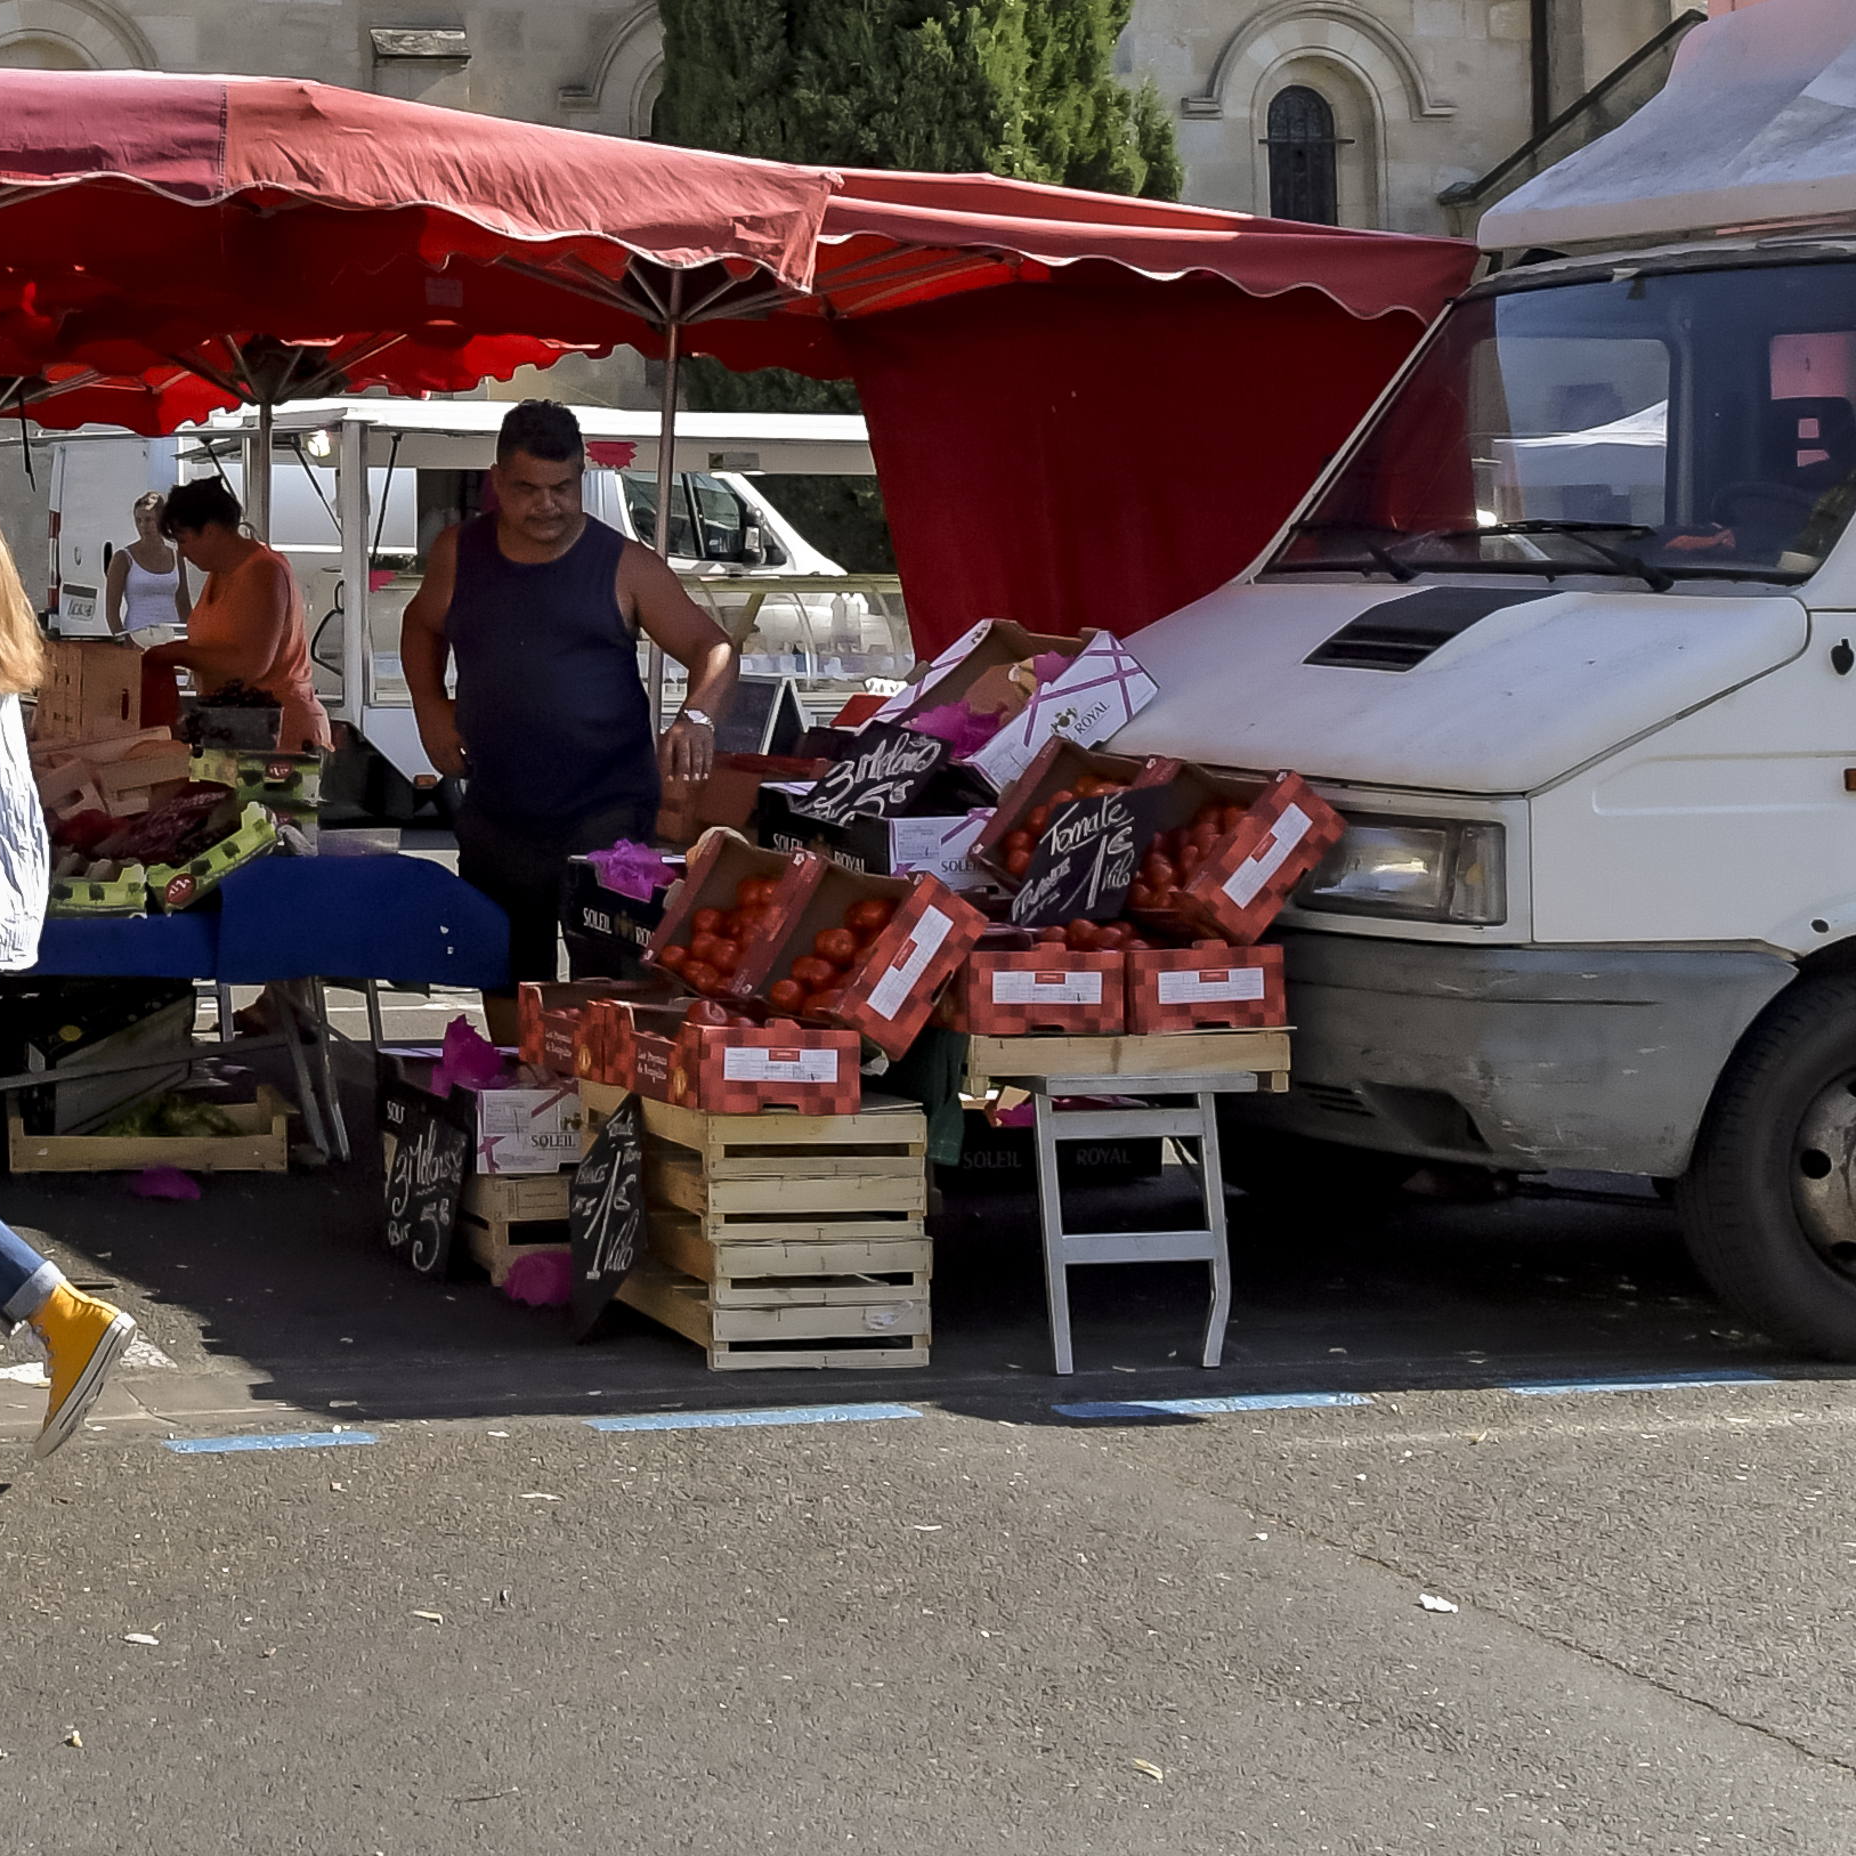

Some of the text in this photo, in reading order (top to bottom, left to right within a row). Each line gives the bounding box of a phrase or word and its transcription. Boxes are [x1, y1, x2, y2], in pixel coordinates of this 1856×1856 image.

[1074, 700, 1111, 735] ROYAL
[1039, 791, 1134, 856] Tomate
[531, 1135, 576, 1148] SOLEIL
[963, 1146, 1132, 1170] SOLEIL ROYAL
